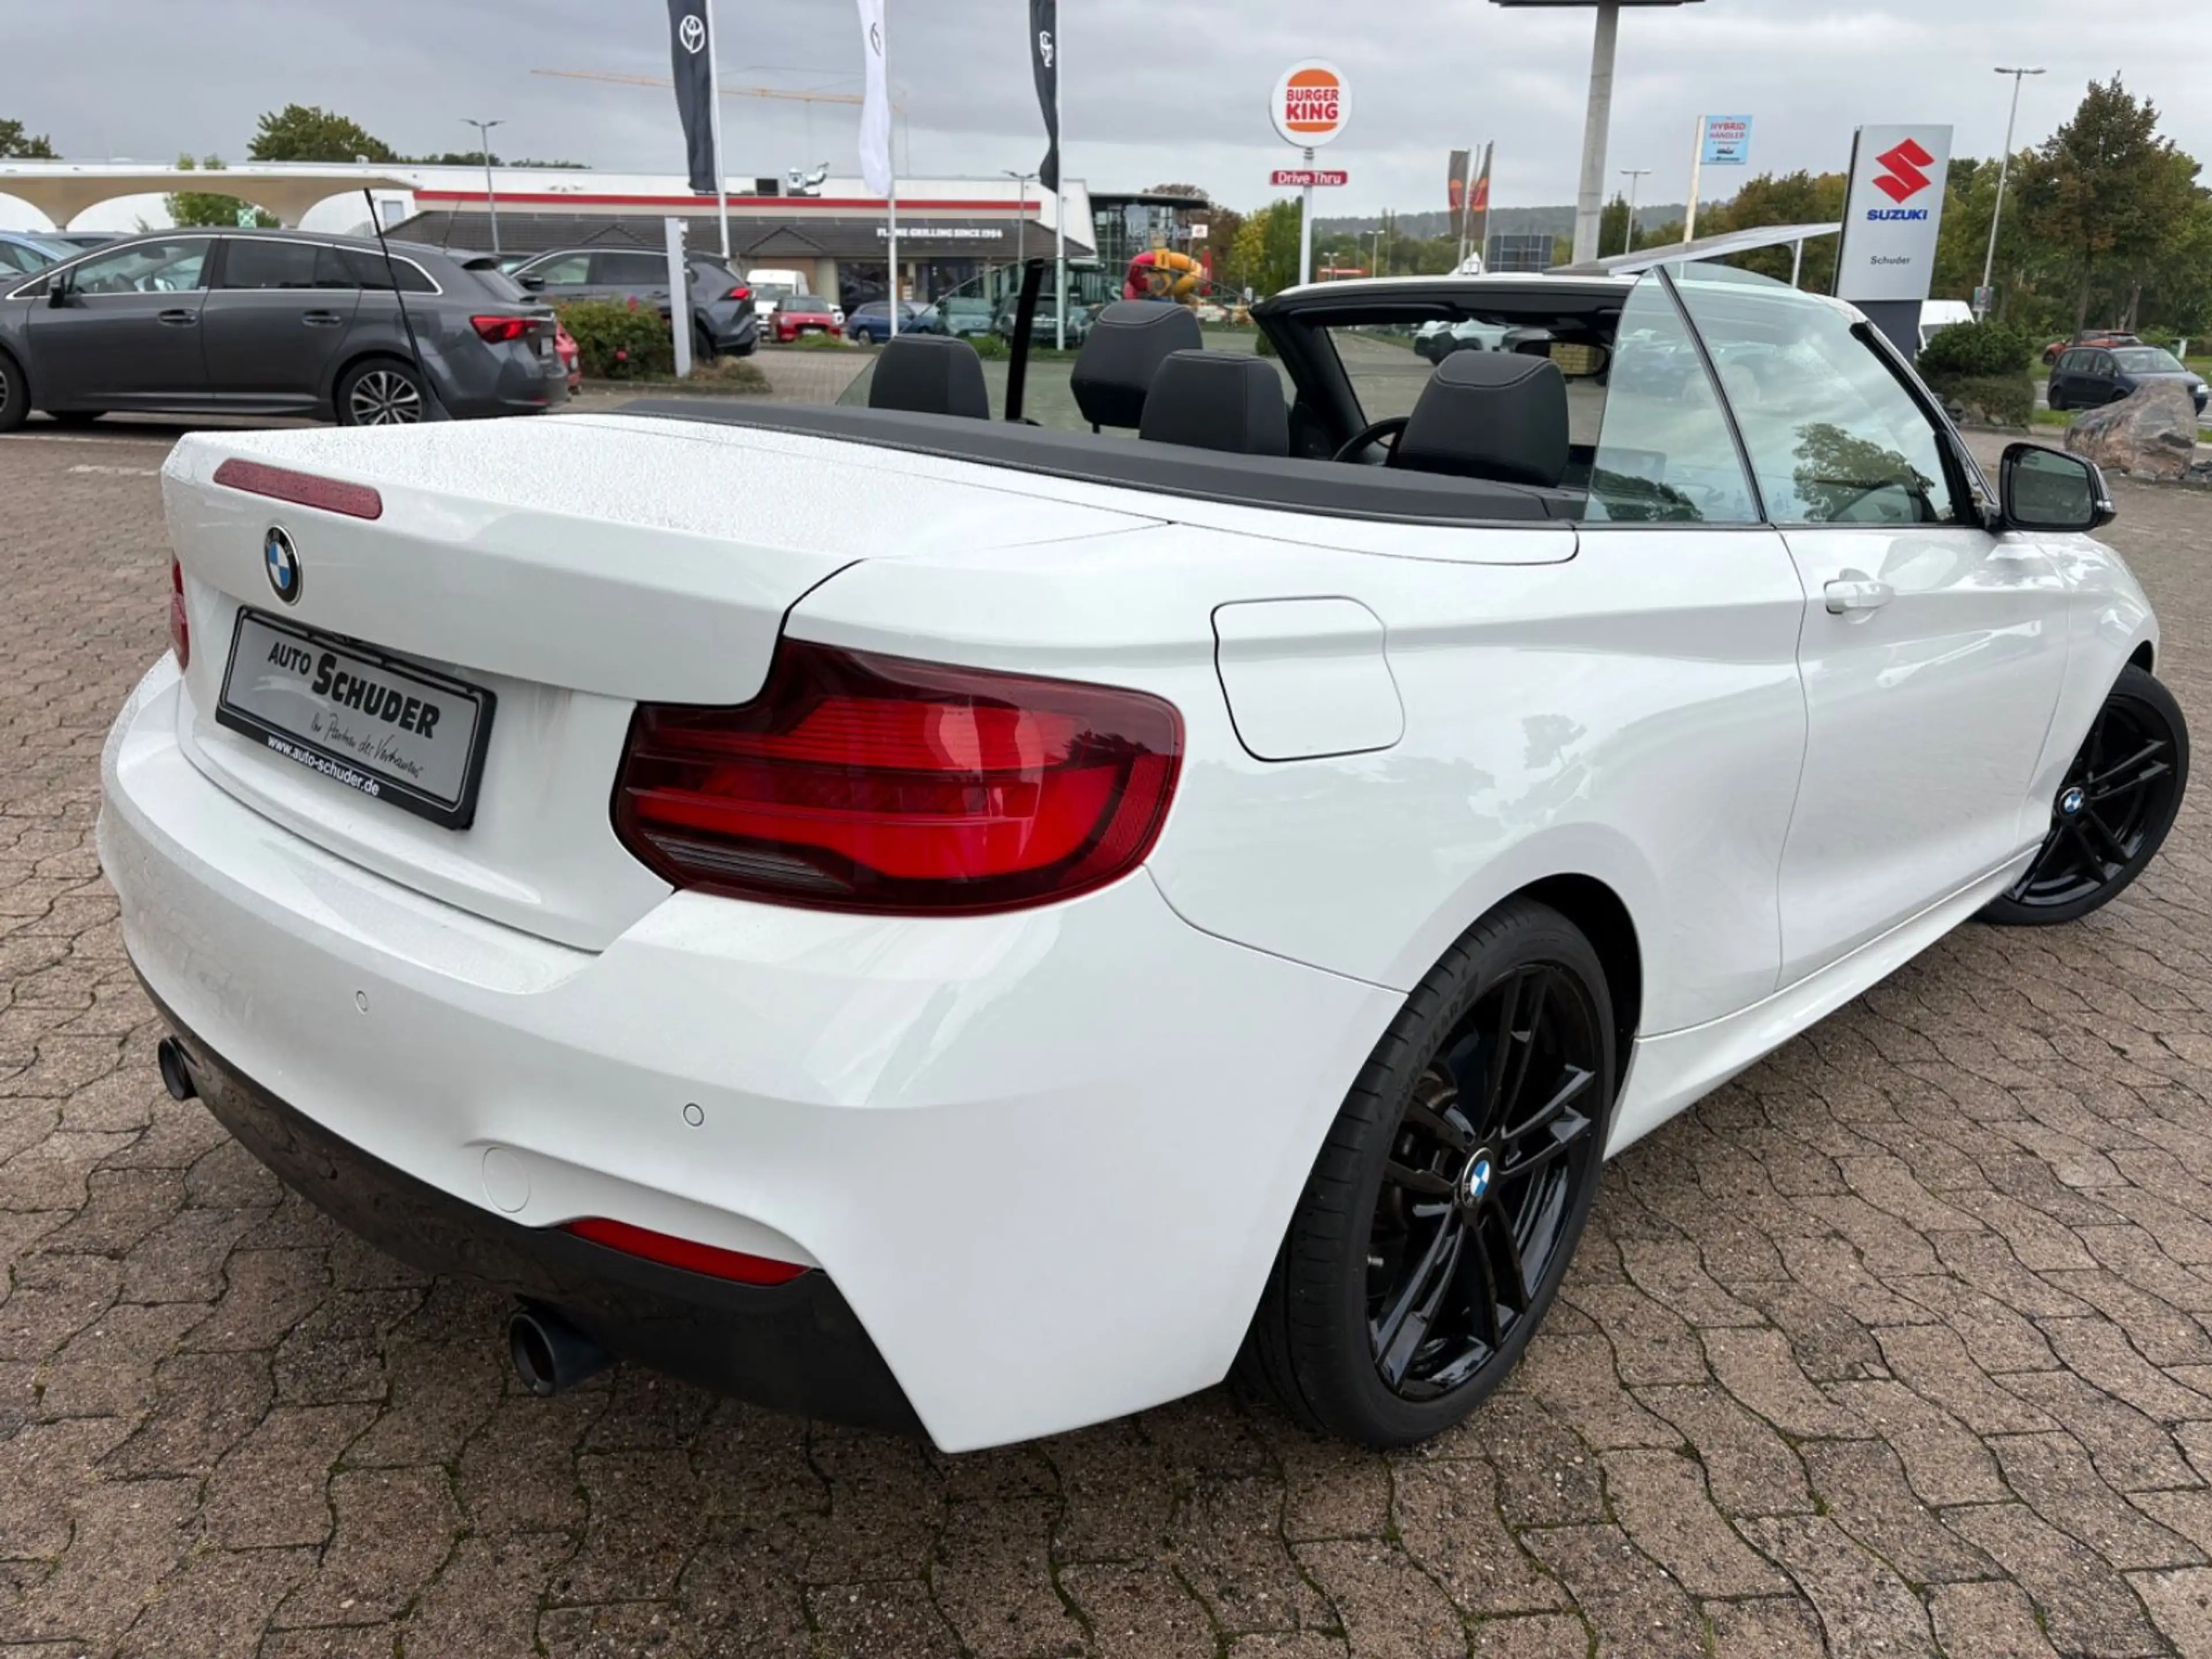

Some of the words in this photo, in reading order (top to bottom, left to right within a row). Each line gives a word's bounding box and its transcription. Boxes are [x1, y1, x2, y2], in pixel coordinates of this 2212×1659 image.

[1286, 89, 1339, 101] BURGER
[1286, 103, 1338, 120] KING
[1711, 122, 1746, 130] HYBRID
[1278, 172, 1309, 183] Drive
[1314, 172, 1341, 184] Thru
[1866, 209, 1928, 220] SUZUKI
[1870, 255, 1911, 265] Schuder
[268, 641, 311, 676] AUTO
[267, 734, 380, 797] www.auto-schuder.de
